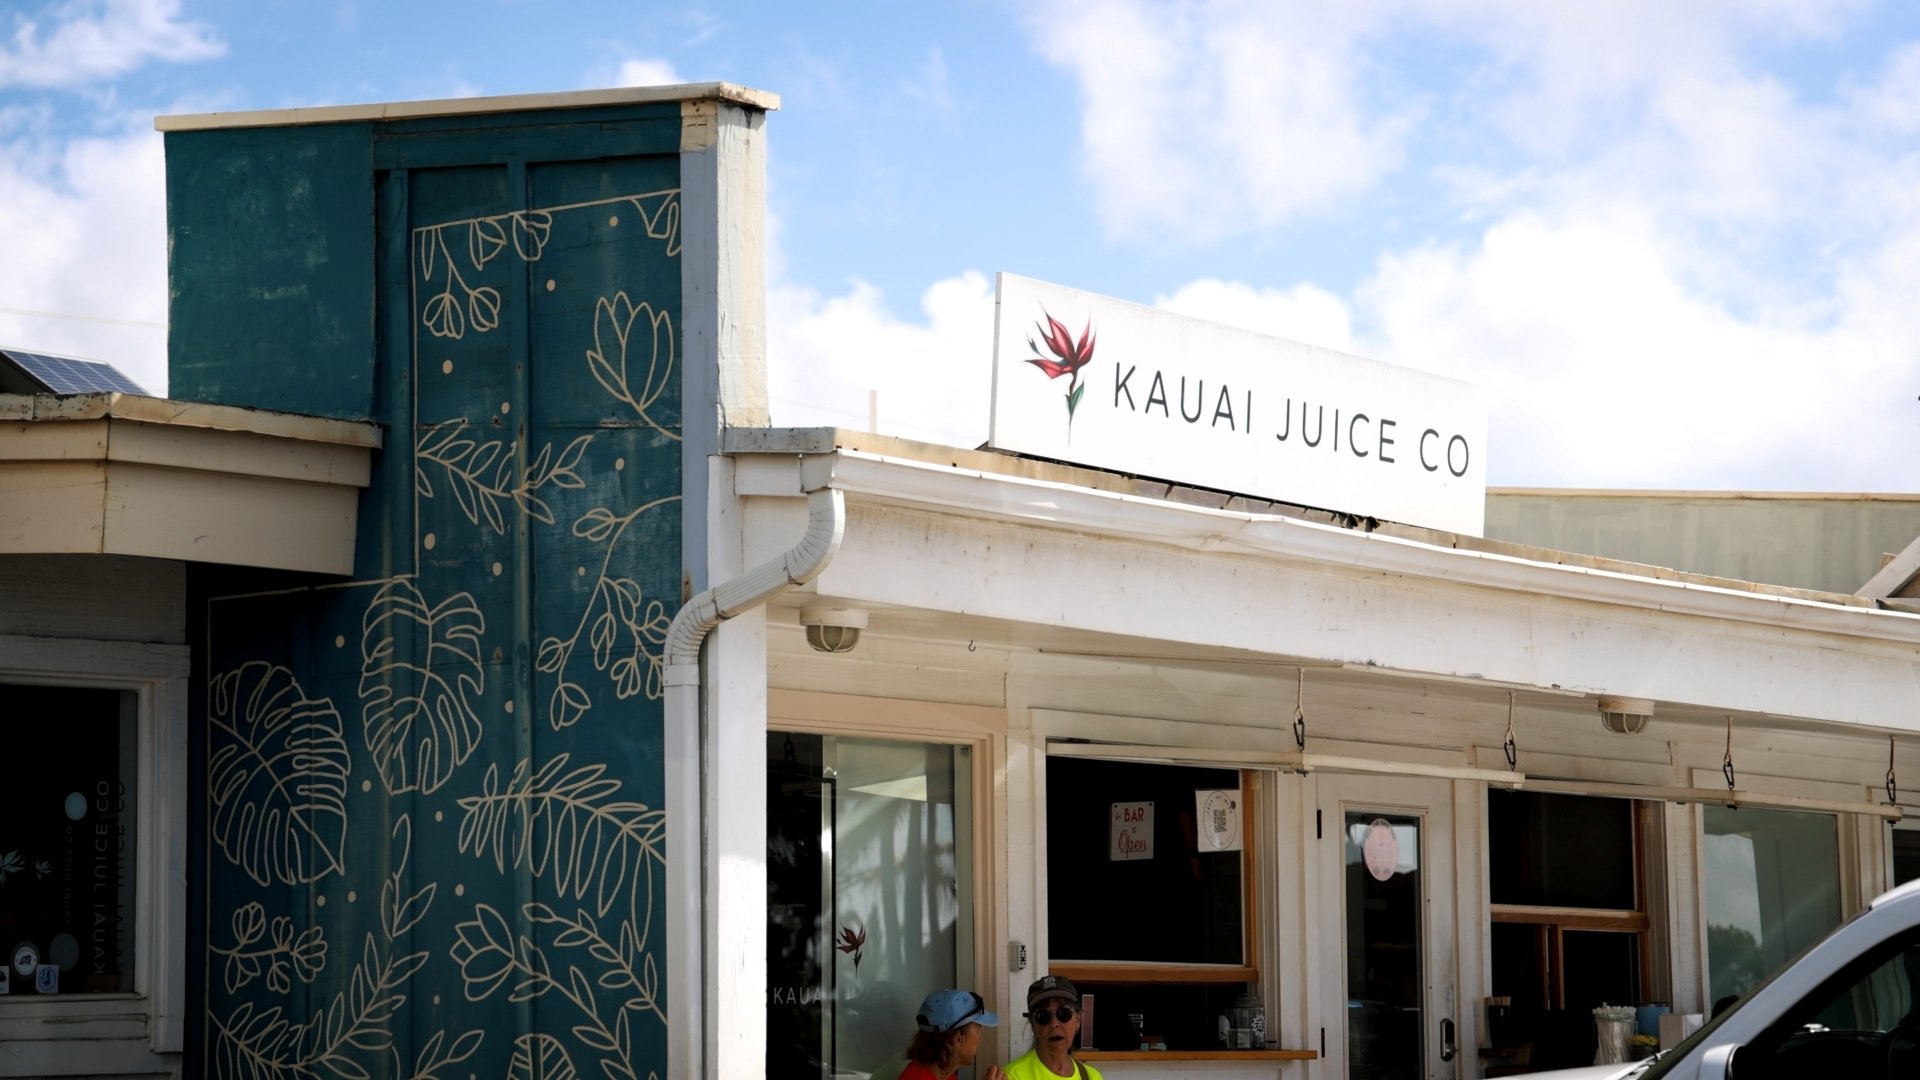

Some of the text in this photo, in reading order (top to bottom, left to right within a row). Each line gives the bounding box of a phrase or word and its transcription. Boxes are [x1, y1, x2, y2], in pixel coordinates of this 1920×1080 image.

[1114, 361, 1470, 478] KAUAI JUICE CO
[1124, 808, 1144, 822] BAR
[1118, 829, 1148, 858] Open
[773, 986, 824, 1005] KAUA
